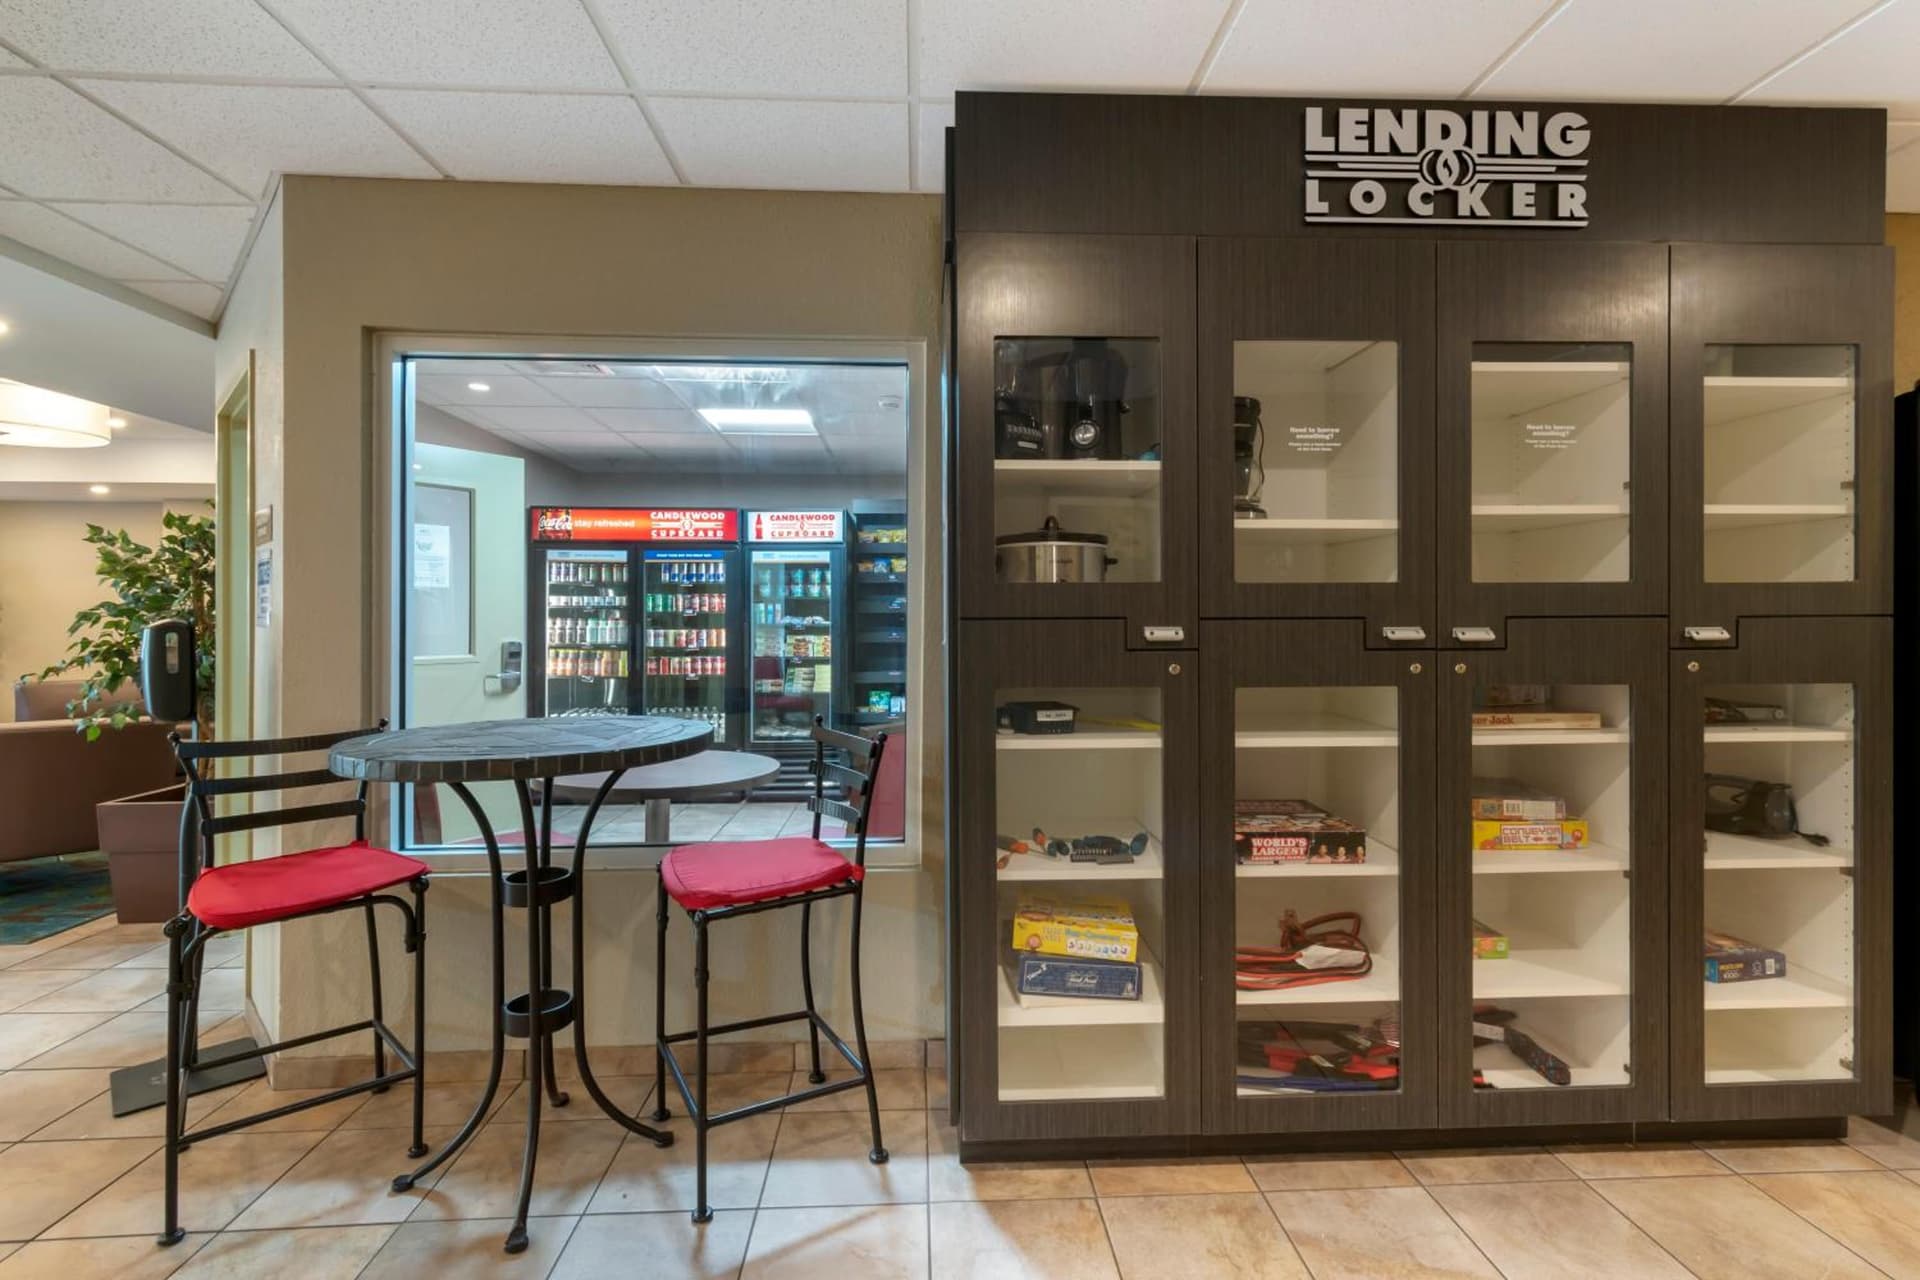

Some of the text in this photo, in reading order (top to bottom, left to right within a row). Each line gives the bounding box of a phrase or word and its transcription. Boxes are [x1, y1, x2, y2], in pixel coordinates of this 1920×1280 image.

[1305, 107, 1591, 157] LENDING
[1305, 179, 1589, 218] LOCKER
[650, 511, 725, 521] CANDLEWOOD
[574, 518, 635, 529] stay refreshed
[651, 529, 724, 537] CUPBOARD
[1491, 713, 1515, 725] Jack
[1251, 837, 1308, 847] WORLD'S
[1502, 835, 1531, 843] BELT
[1252, 847, 1307, 857] LARGEST
